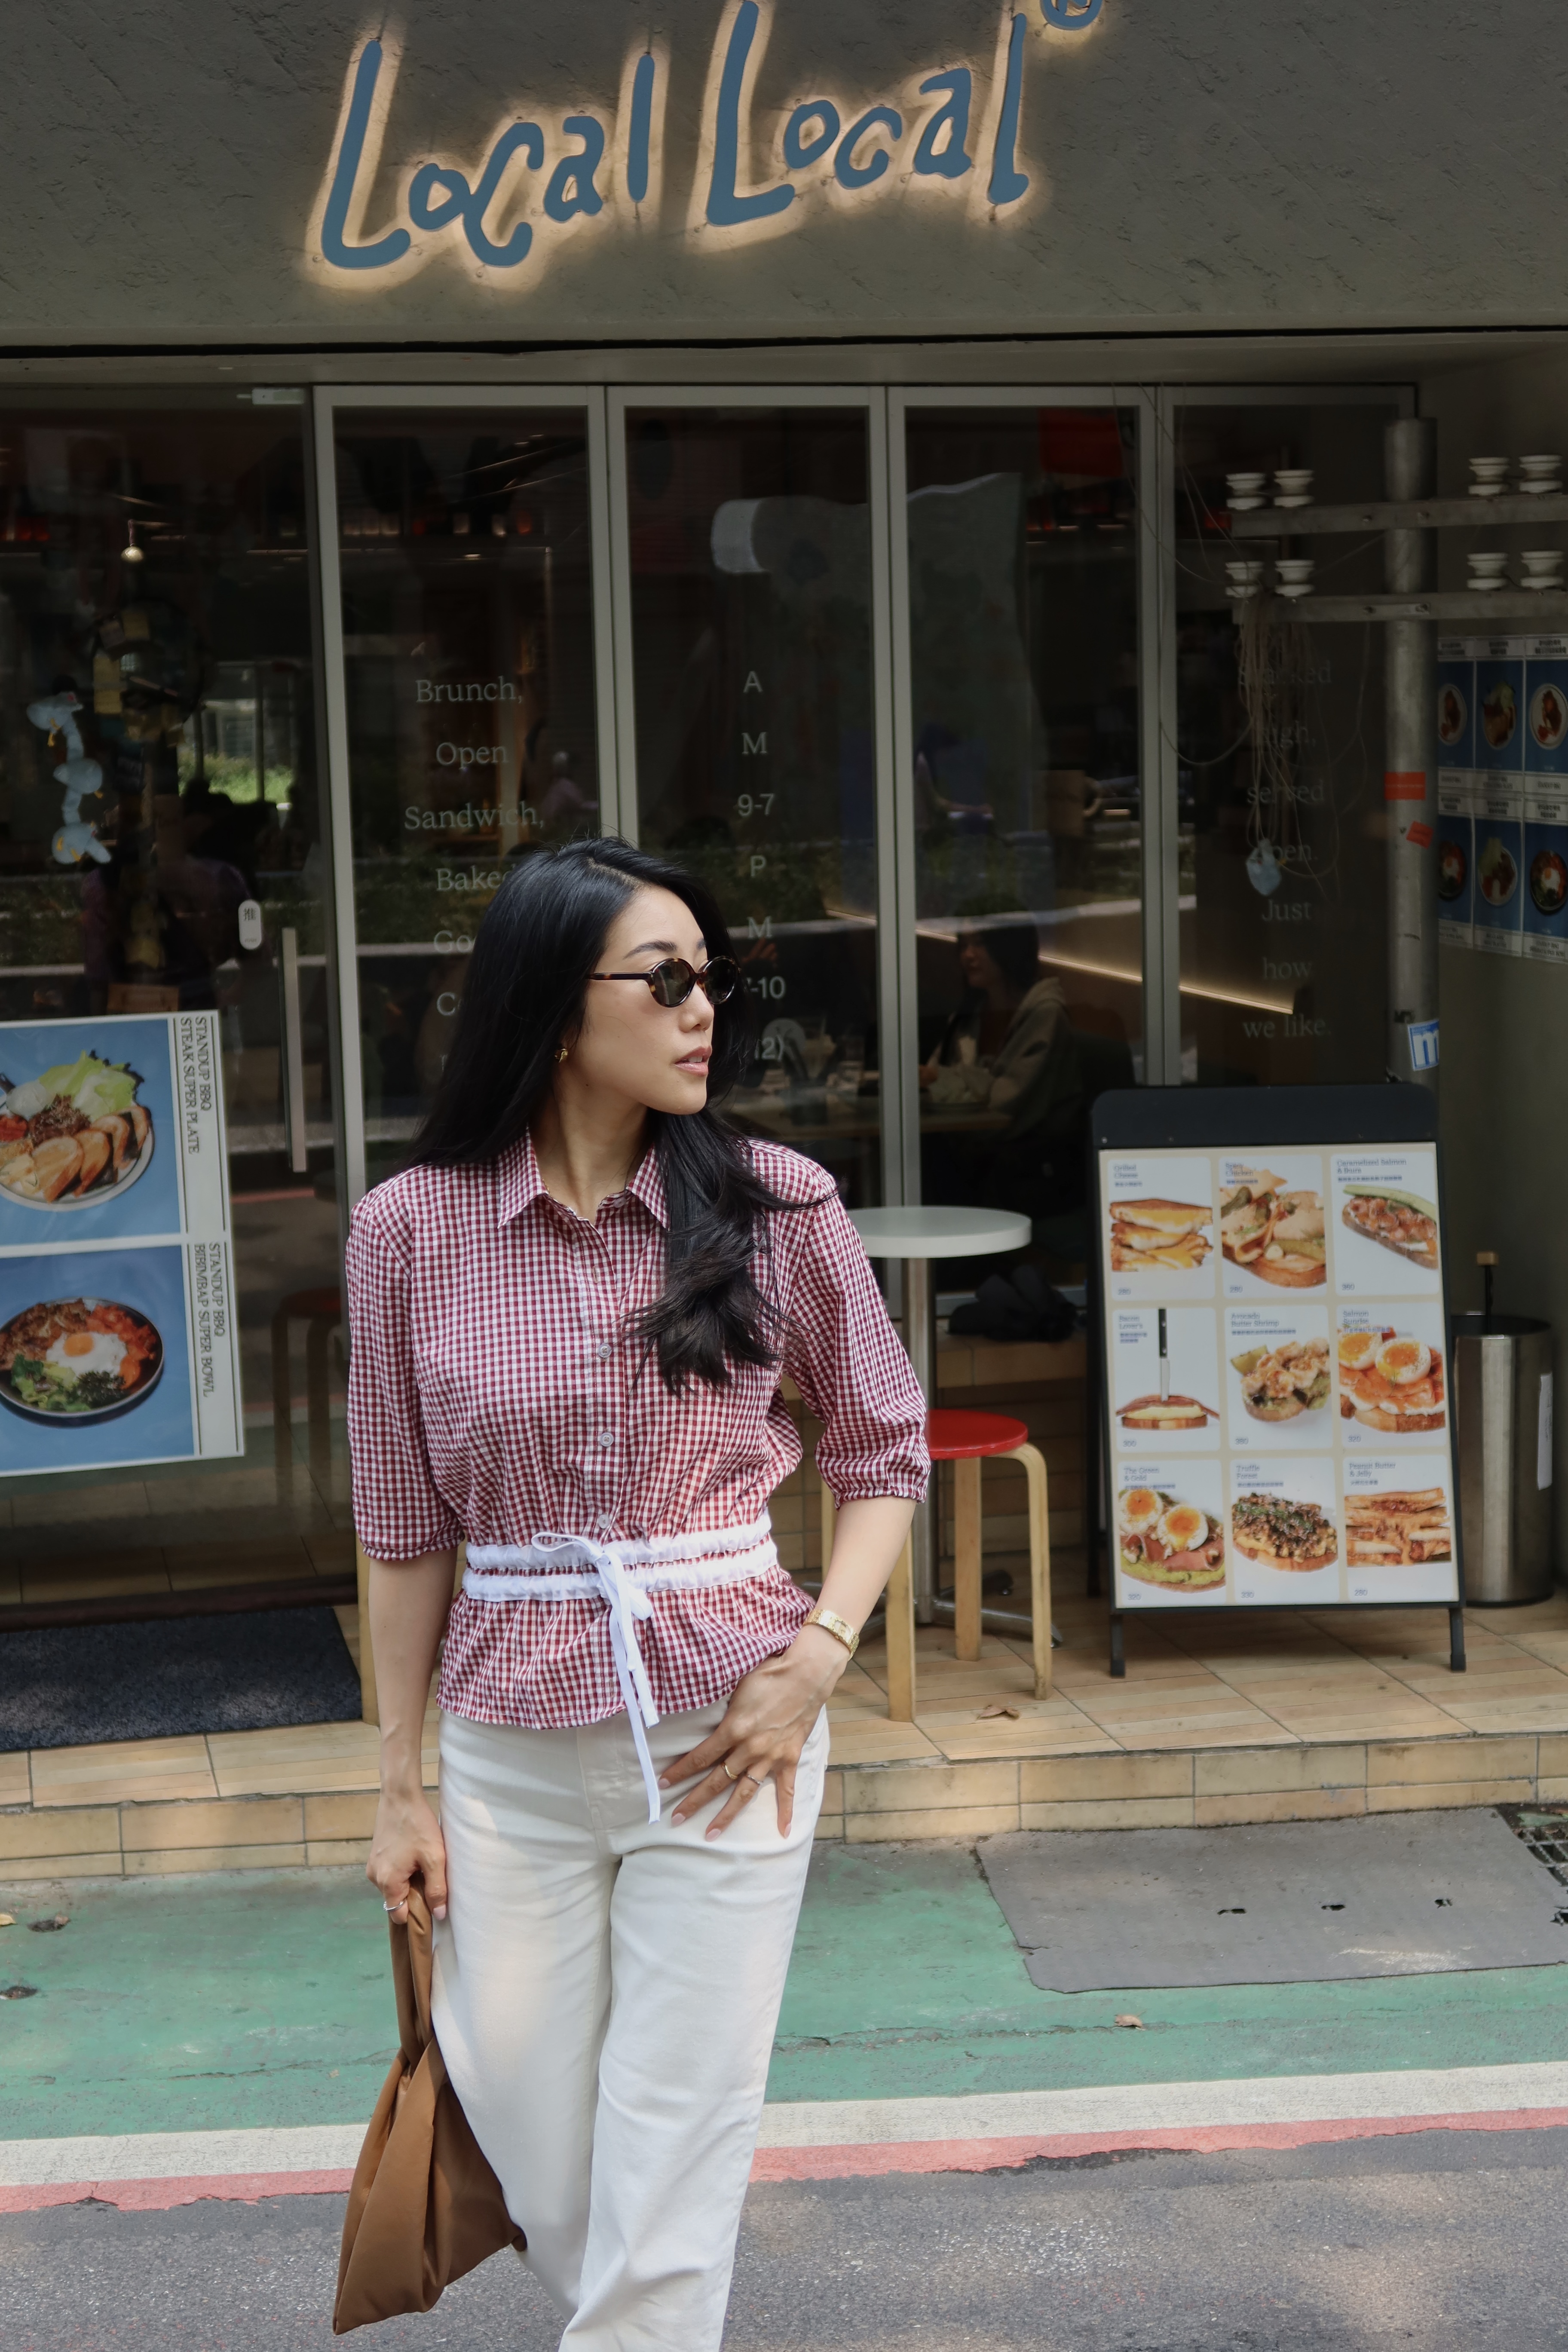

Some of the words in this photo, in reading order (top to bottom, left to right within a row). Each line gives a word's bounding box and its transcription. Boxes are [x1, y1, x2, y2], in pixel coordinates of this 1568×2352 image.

[321, 40, 655, 269] Local
[707, 0, 1029, 226] Local
[415, 676, 522, 703] Brunch,
[743, 671, 763, 693] A
[436, 742, 509, 770] Open
[741, 732, 767, 754] M
[404, 801, 543, 830] Sandwich,
[738, 793, 775, 817] 9-7
[750, 855, 767, 877] P
[243, 908, 256, 921] 推
[1262, 898, 1311, 922] Just
[747, 916, 772, 938] M
[1262, 956, 1311, 980] how
[181, 1017, 193, 1062] STEAK
[1242, 1020, 1275, 1038] we
[1283, 1013, 1331, 1037] like.
[196, 1016, 210, 1081] STANDUP
[184, 1065, 196, 1109] SUPER
[199, 1083, 211, 1111] BBQ
[187, 1112, 199, 1155] PLATE
[194, 1244, 208, 1307] BIBIMBAP
[209, 1242, 223, 1307] STANDUP
[199, 1310, 211, 1354] SUPER
[213, 1309, 225, 1337] BBQ
[1254, 1320, 1280, 1328] Shrimp
[201, 1357, 214, 1397] BOWL
[1357, 1470, 1372, 1478] Jelly
